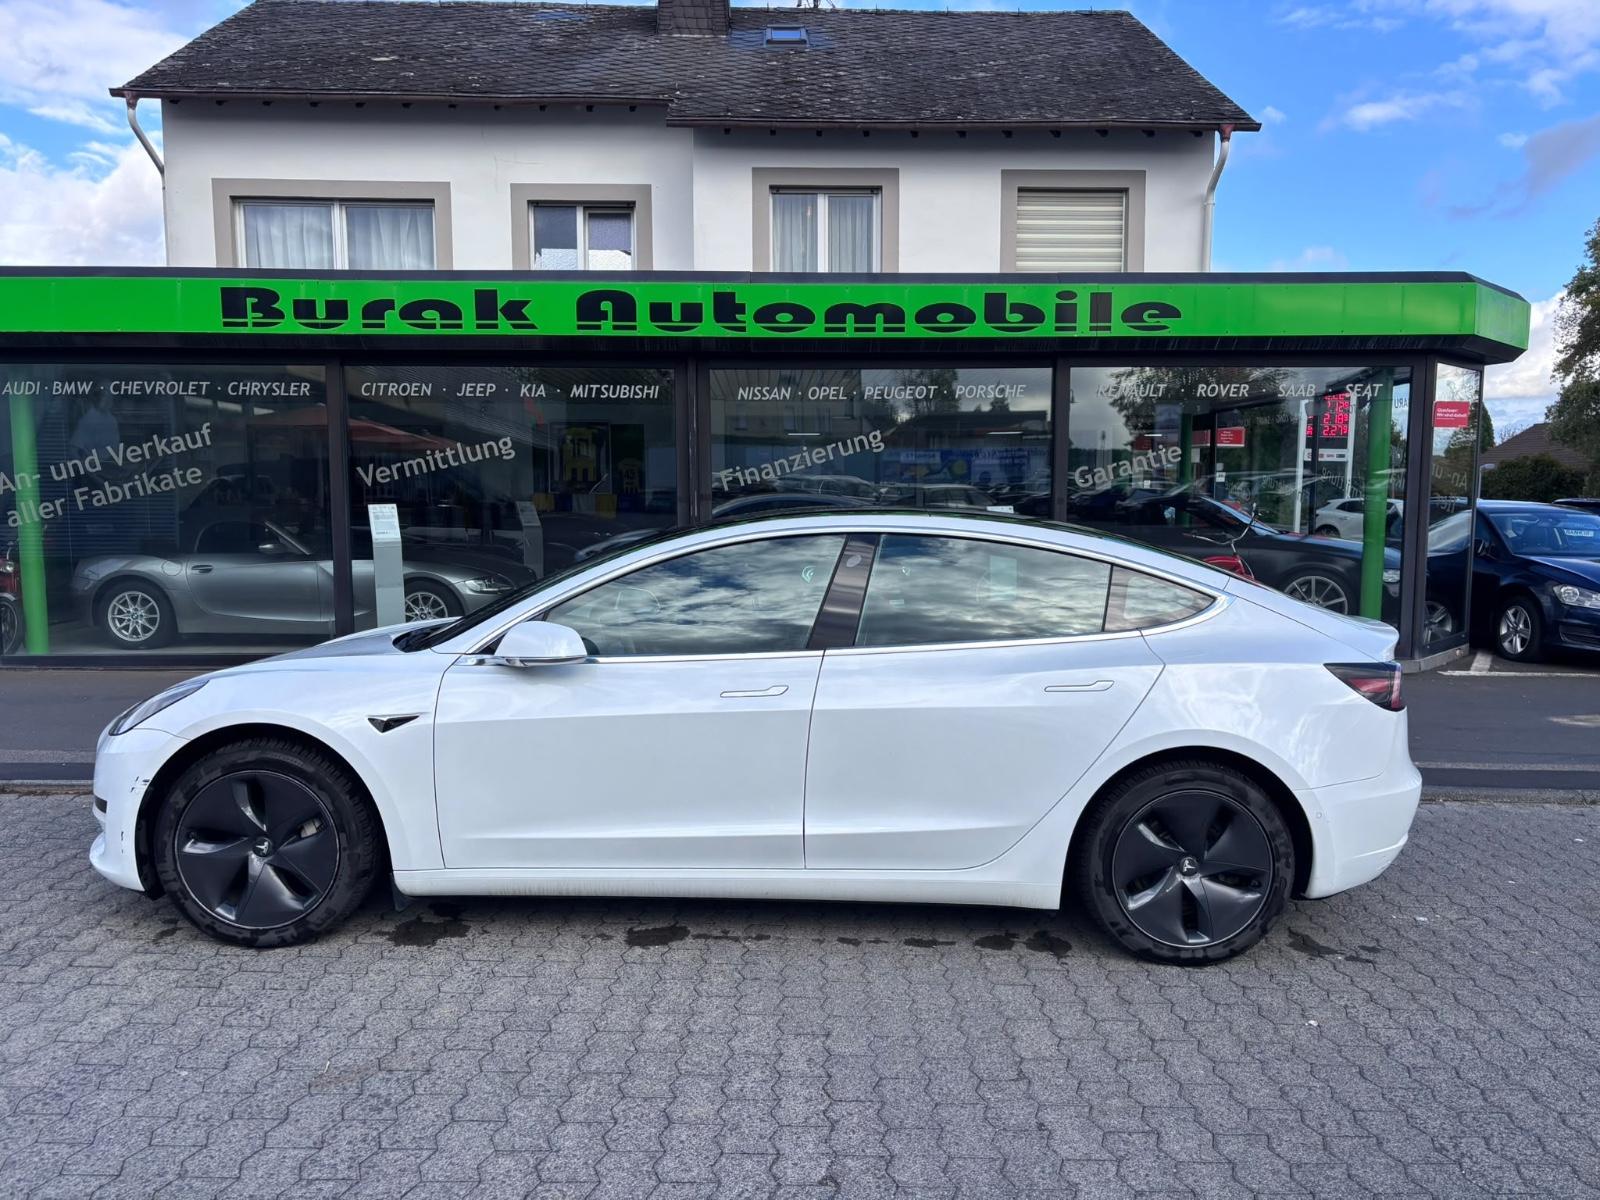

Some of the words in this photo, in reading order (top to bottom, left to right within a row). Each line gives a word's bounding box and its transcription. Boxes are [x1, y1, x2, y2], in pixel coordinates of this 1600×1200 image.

[220, 286, 539, 330] Burak
[576, 289, 1182, 334] Automobile
[2, 381, 41, 395] AUDI
[52, 381, 93, 395] BMW
[109, 381, 210, 396] CHEVROLET
[227, 381, 311, 397] CHRYSLER
[361, 382, 432, 397] CITROEN
[456, 383, 496, 397] JEEP
[520, 383, 546, 398] KIA
[570, 384, 660, 399] MITSUBISHI
[737, 387, 791, 401] NISSAN
[807, 387, 848, 401] OPEL
[863, 385, 938, 401] PEUGEOT
[954, 384, 1026, 400] PORSCHE
[1096, 383, 1167, 398] RENAULT
[1196, 384, 1249, 398] ROVER
[1277, 383, 1317, 398] SAAB
[1345, 383, 1384, 398] SEAT
[0, 472, 41, 494] An-
[49, 451, 102, 481] und
[107, 423, 212, 466] Verkauf
[356, 436, 516, 487] Vermittlung
[719, 430, 885, 491] Finanzierung
[1074, 445, 1182, 487] Garantie
[7, 498, 65, 528] aller
[75, 467, 202, 511] Fabrikate
